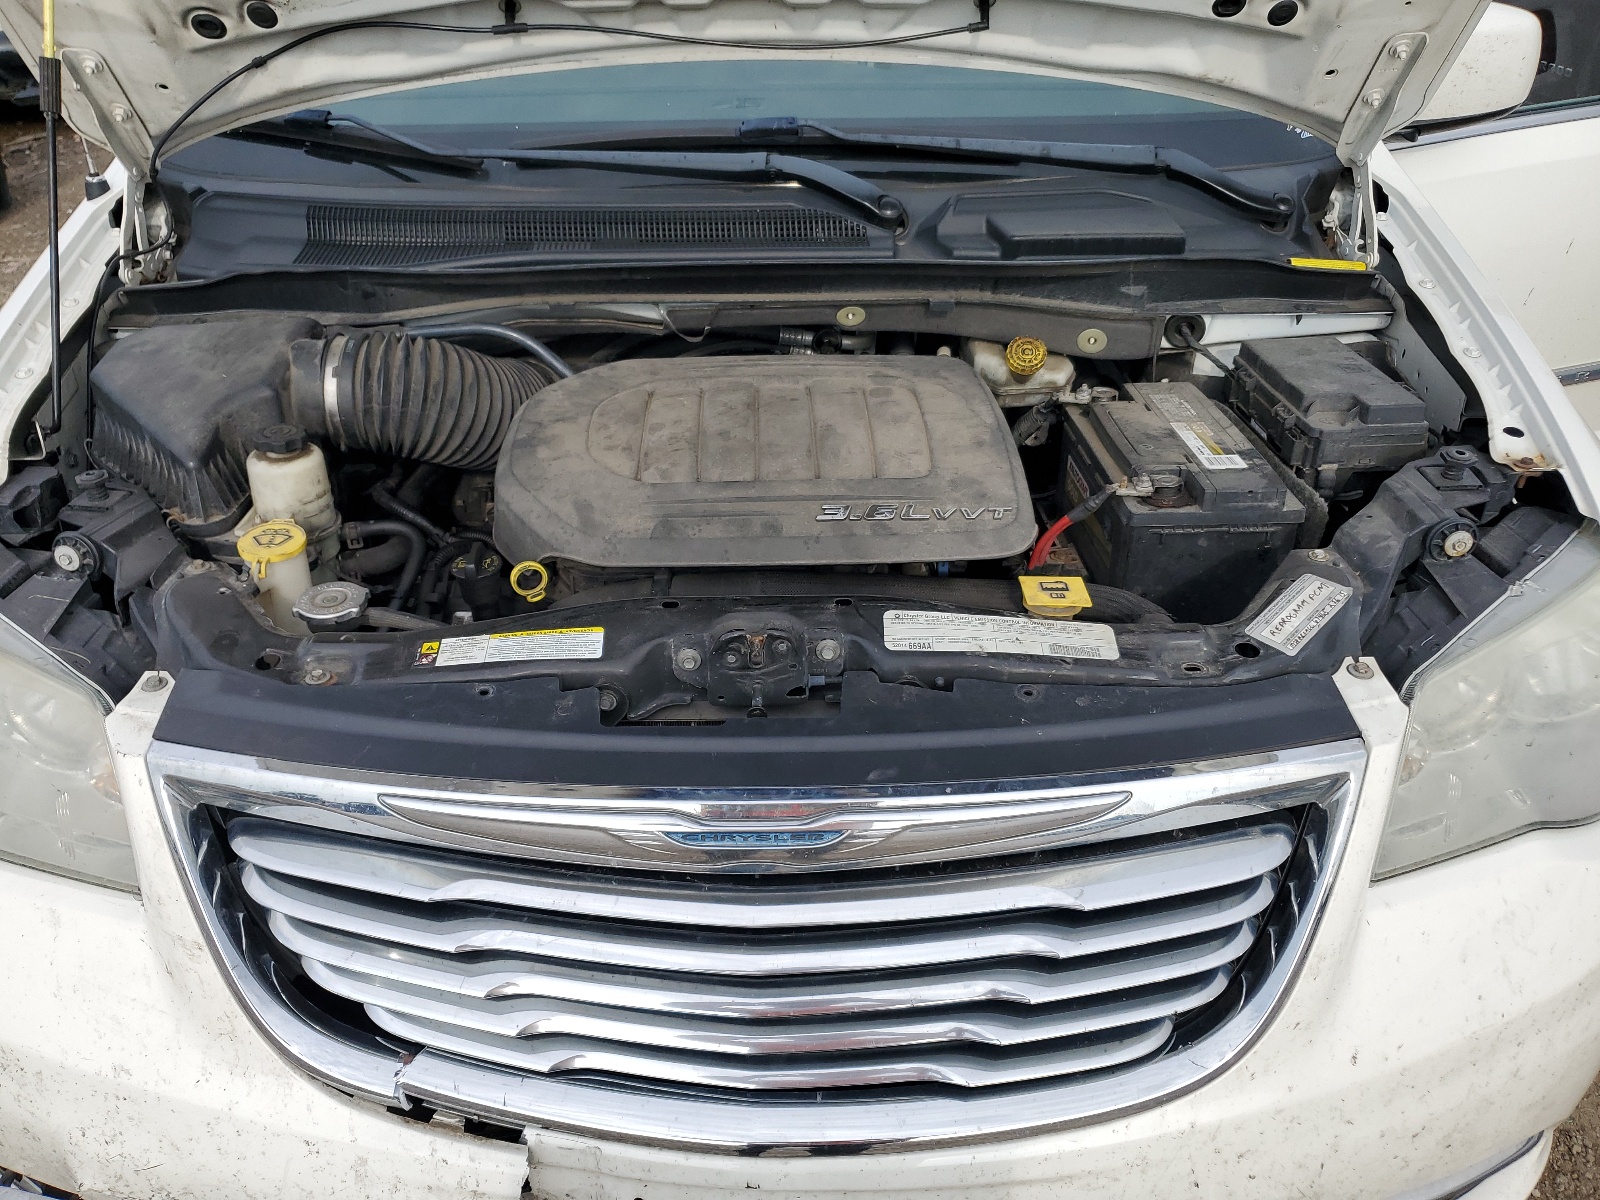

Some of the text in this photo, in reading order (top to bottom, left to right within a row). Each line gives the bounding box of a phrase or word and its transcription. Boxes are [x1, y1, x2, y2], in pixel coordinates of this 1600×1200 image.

[1269, 599, 1310, 637] REPROGRAM
[1308, 582, 1330, 601] PCM
[682, 833, 826, 842] CHRYSLER
